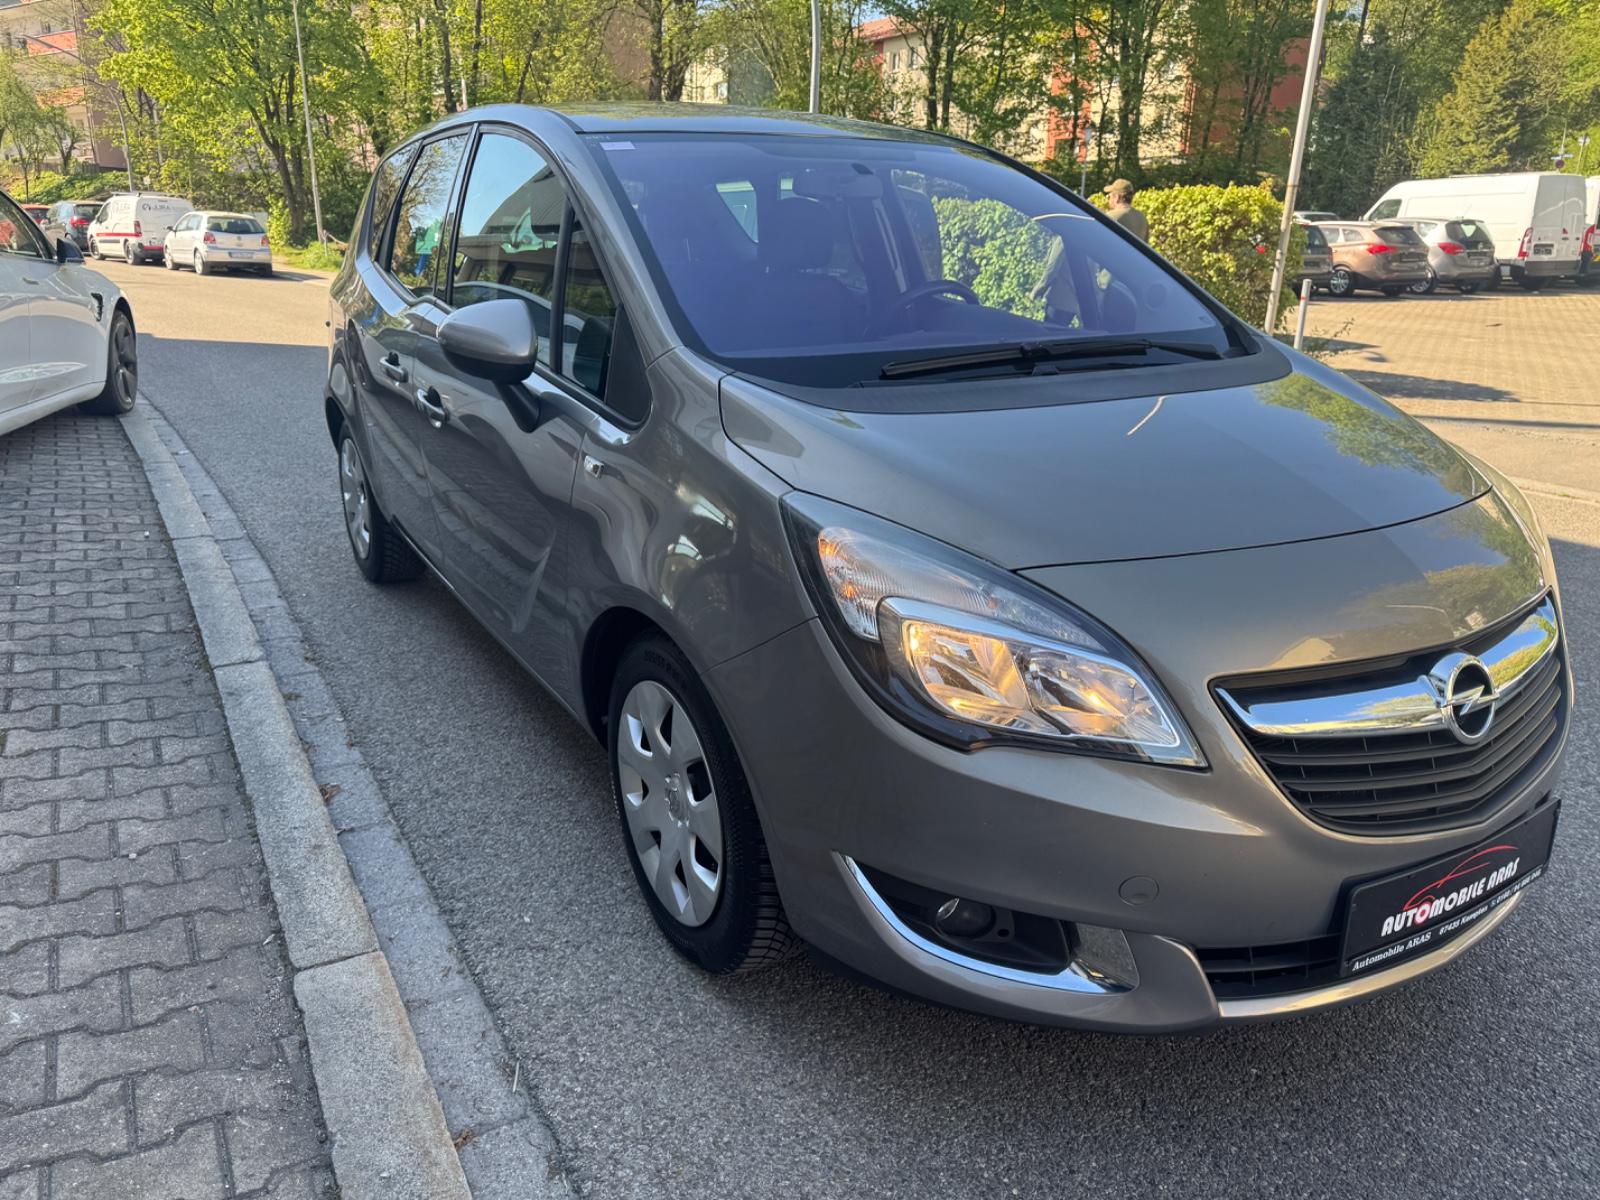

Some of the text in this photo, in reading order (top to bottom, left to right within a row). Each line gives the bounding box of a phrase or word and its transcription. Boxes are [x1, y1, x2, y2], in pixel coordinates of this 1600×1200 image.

[1381, 877, 1487, 937] AUTOMOBILE
[1487, 857, 1520, 891] ARAS
[1352, 945, 1404, 972] Automobile
[1406, 932, 1432, 950] ARAS
